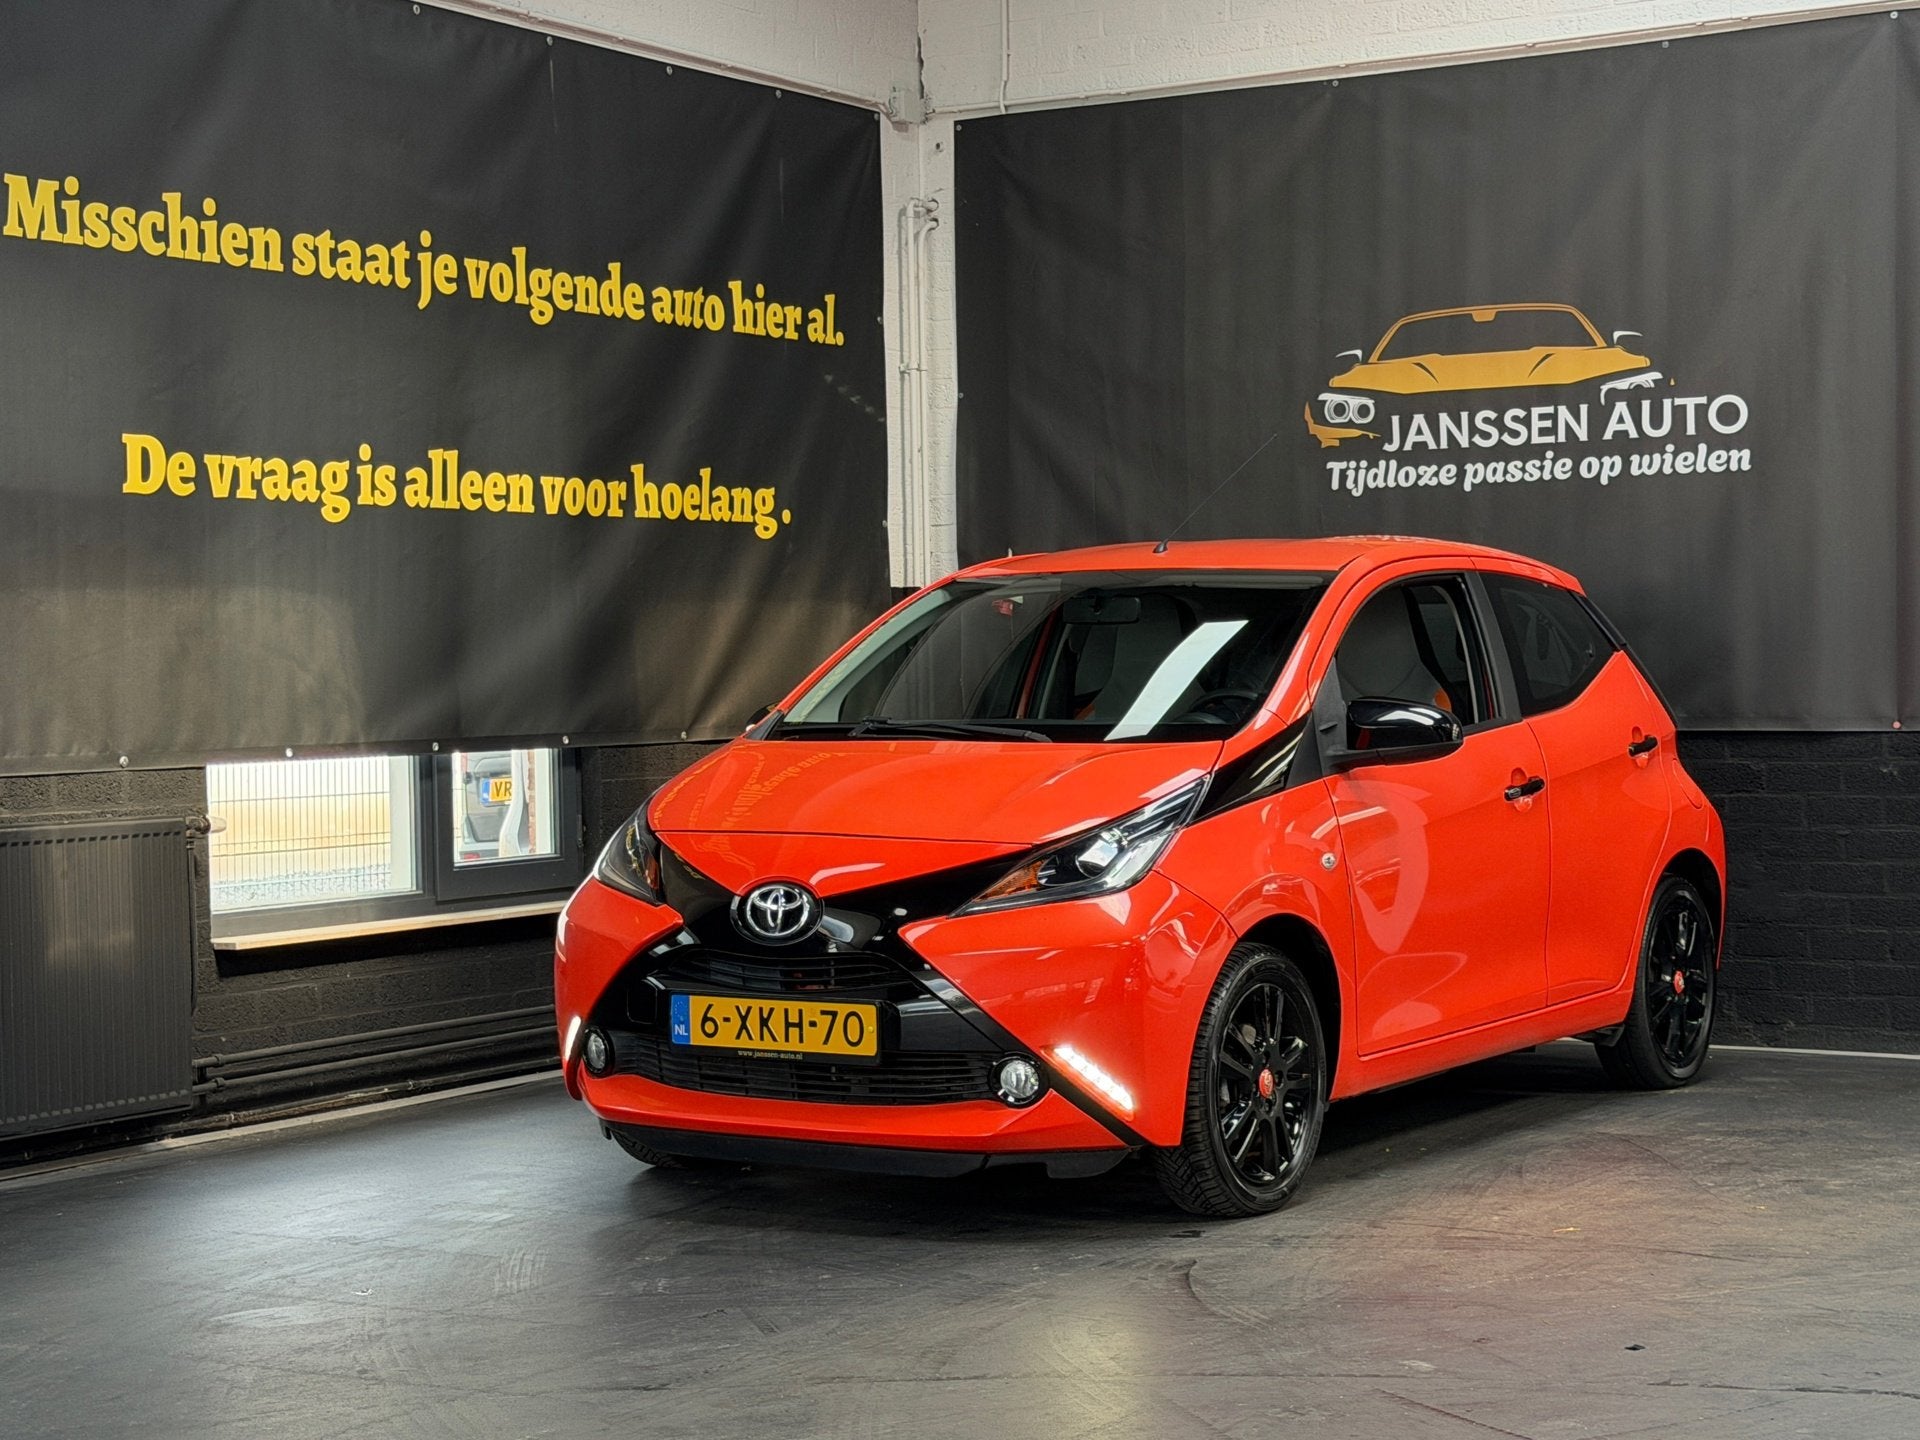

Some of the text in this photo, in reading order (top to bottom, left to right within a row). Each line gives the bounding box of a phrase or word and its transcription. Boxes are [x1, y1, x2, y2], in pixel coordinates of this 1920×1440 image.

[3, 173, 845, 346] Misschien staat je volgende auto hier al.
[1382, 393, 1749, 452] JANSSEN AUTO
[121, 432, 792, 540] De vraag is alleen voor hoelang.
[1325, 443, 1752, 497] Tijdloze passie op wielen
[674, 1023, 689, 1037] NL
[700, 1003, 865, 1048] 6-XKH-70
